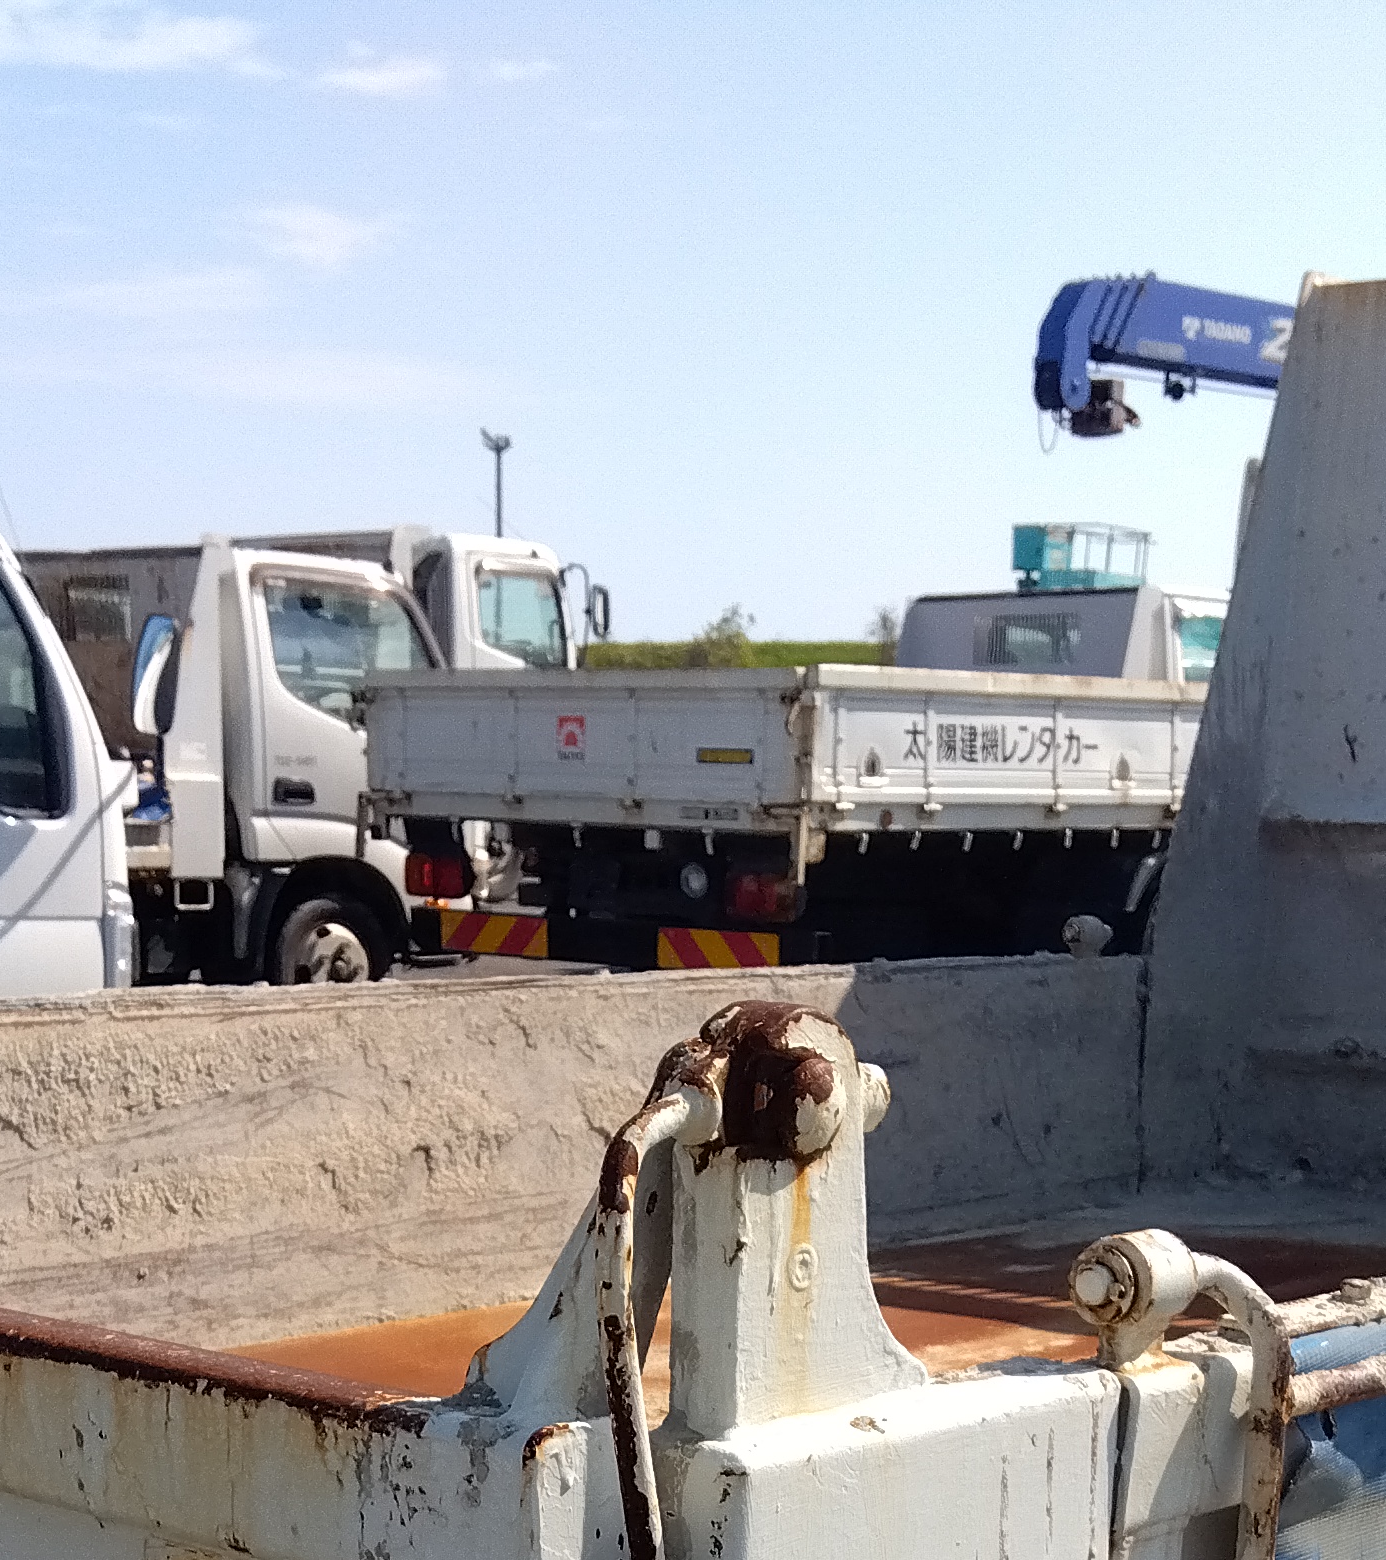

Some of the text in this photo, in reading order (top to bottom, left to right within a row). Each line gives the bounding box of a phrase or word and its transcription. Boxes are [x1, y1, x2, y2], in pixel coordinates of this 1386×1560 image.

[903, 721, 1099, 765] 太陽建機レンタカー
